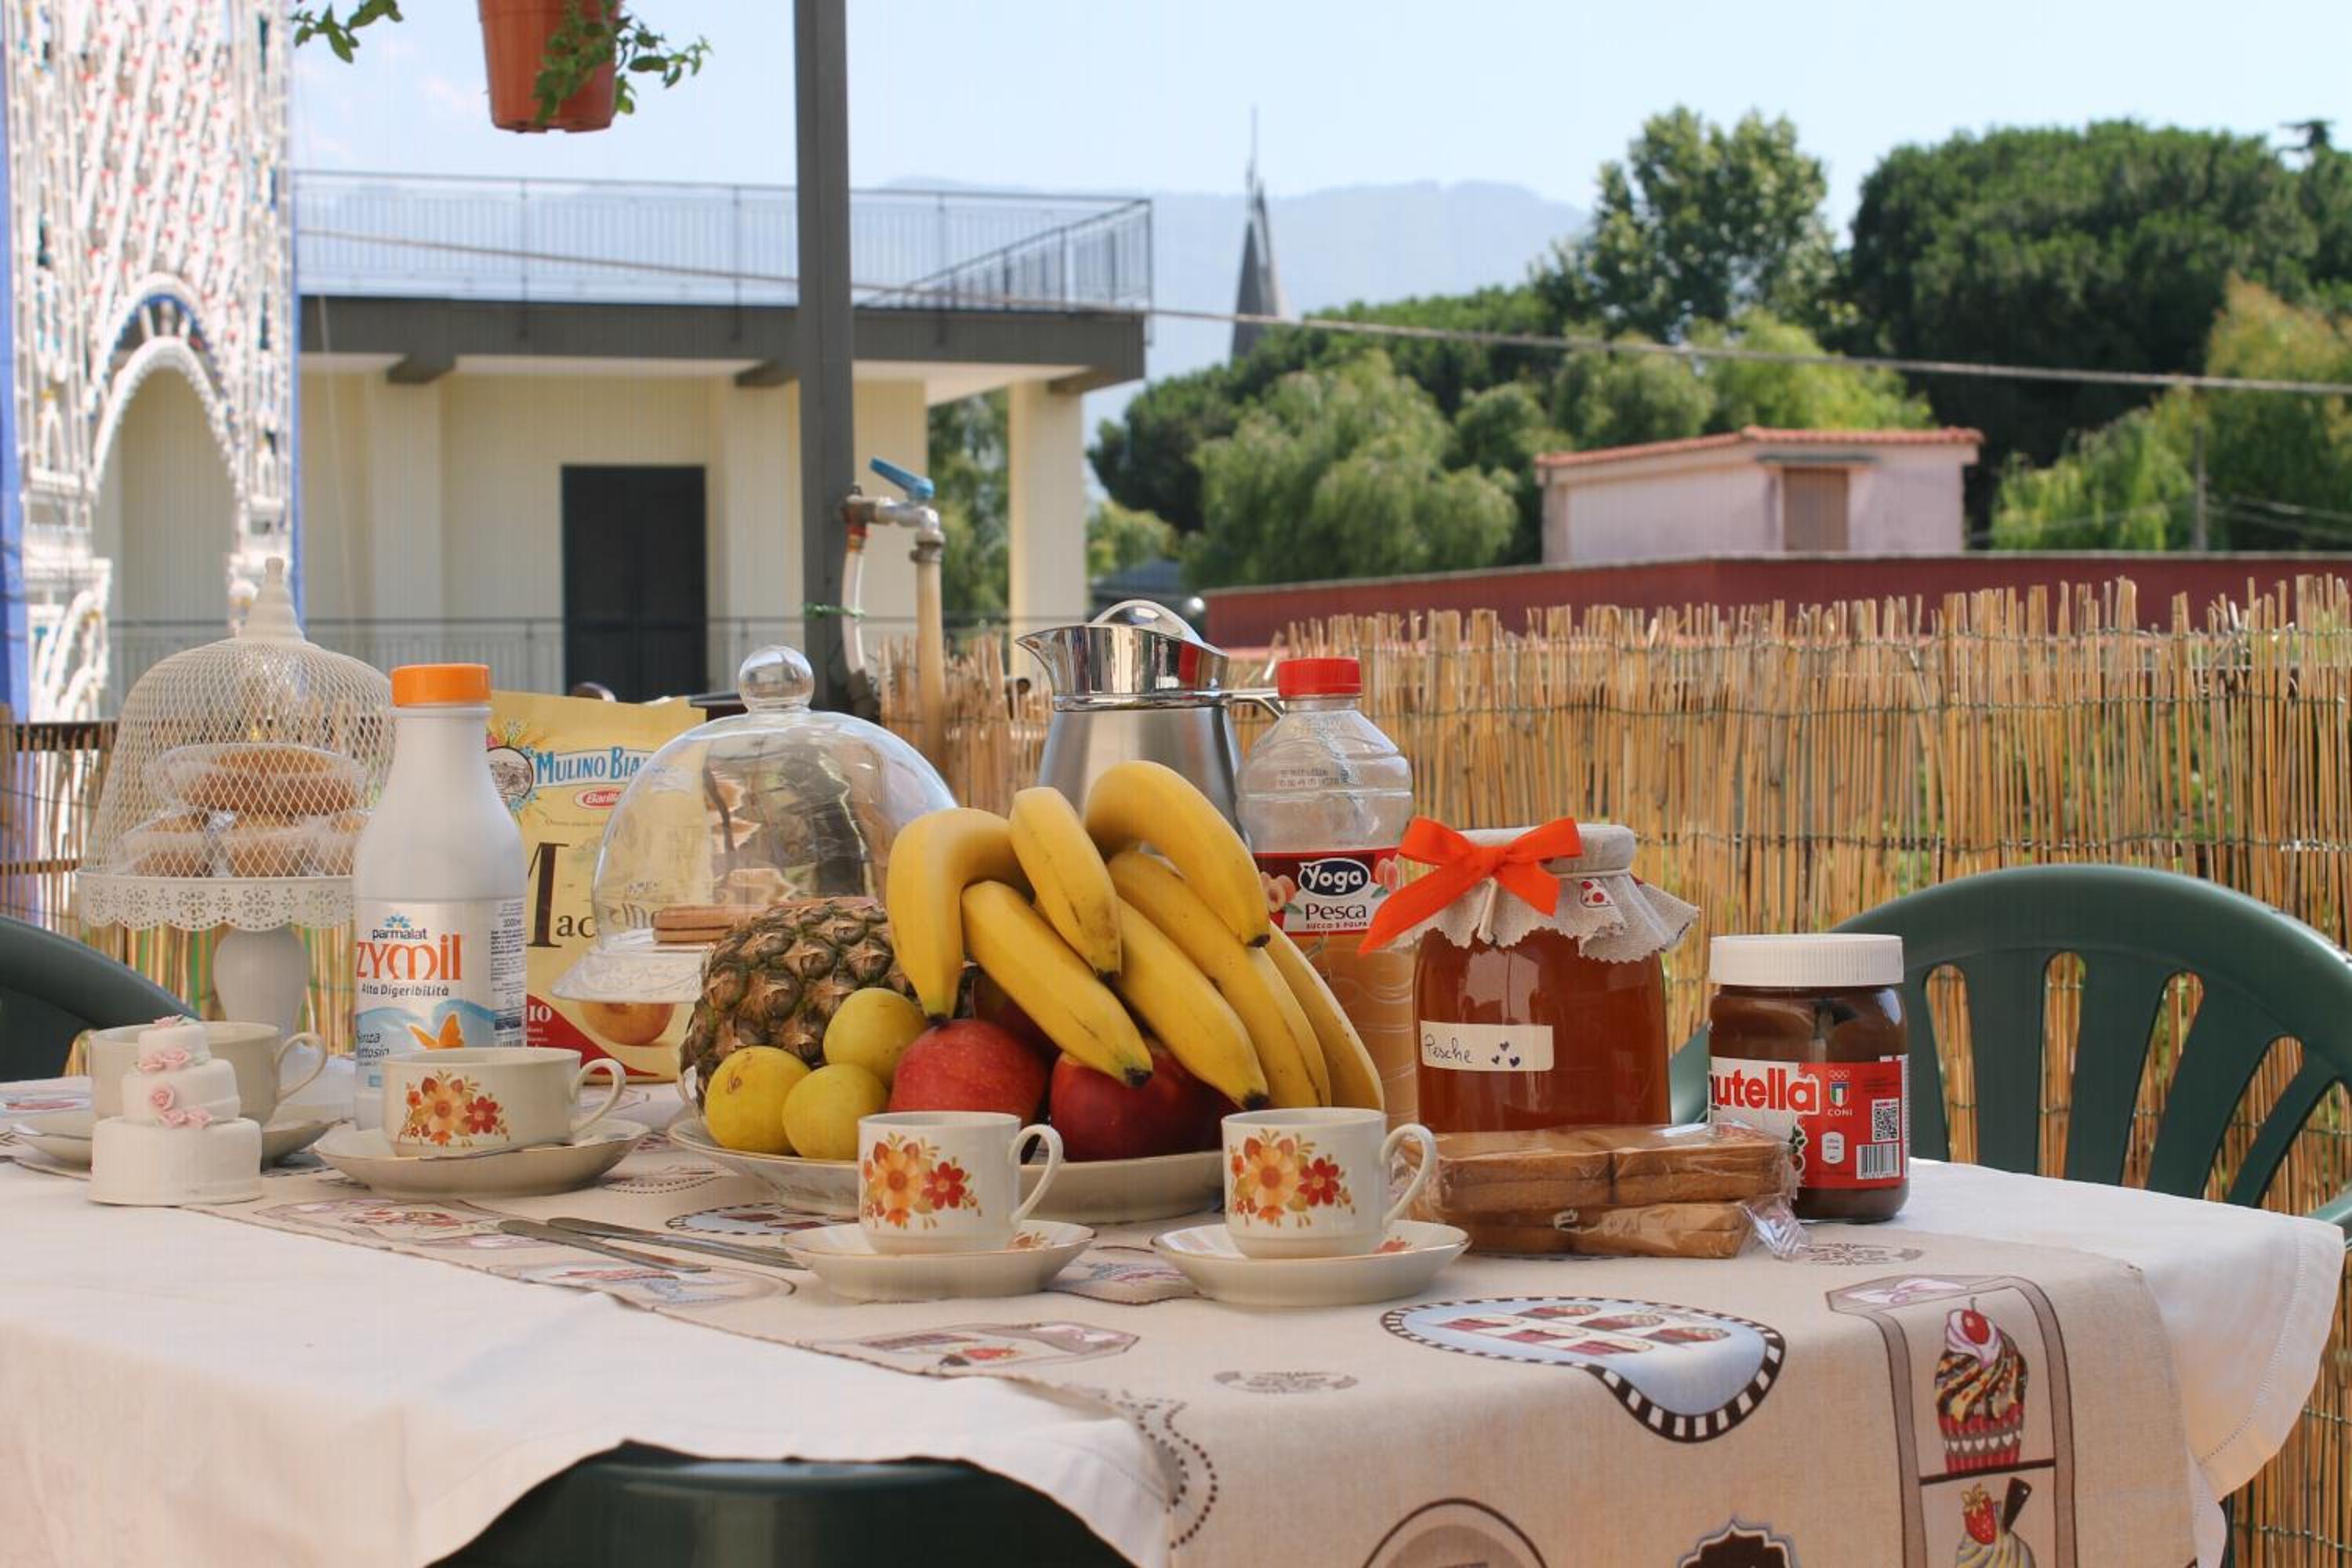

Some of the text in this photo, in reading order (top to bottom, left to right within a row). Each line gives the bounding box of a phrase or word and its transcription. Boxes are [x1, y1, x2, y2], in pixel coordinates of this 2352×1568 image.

[535, 746, 647, 784] MULINO BIA
[1304, 864, 1363, 893] Yoga
[1305, 902, 1367, 920] Pesca
[372, 928, 427, 939] parmalat
[362, 983, 449, 998] Alta Digeribilità
[1425, 1033, 1472, 1064] Pesche
